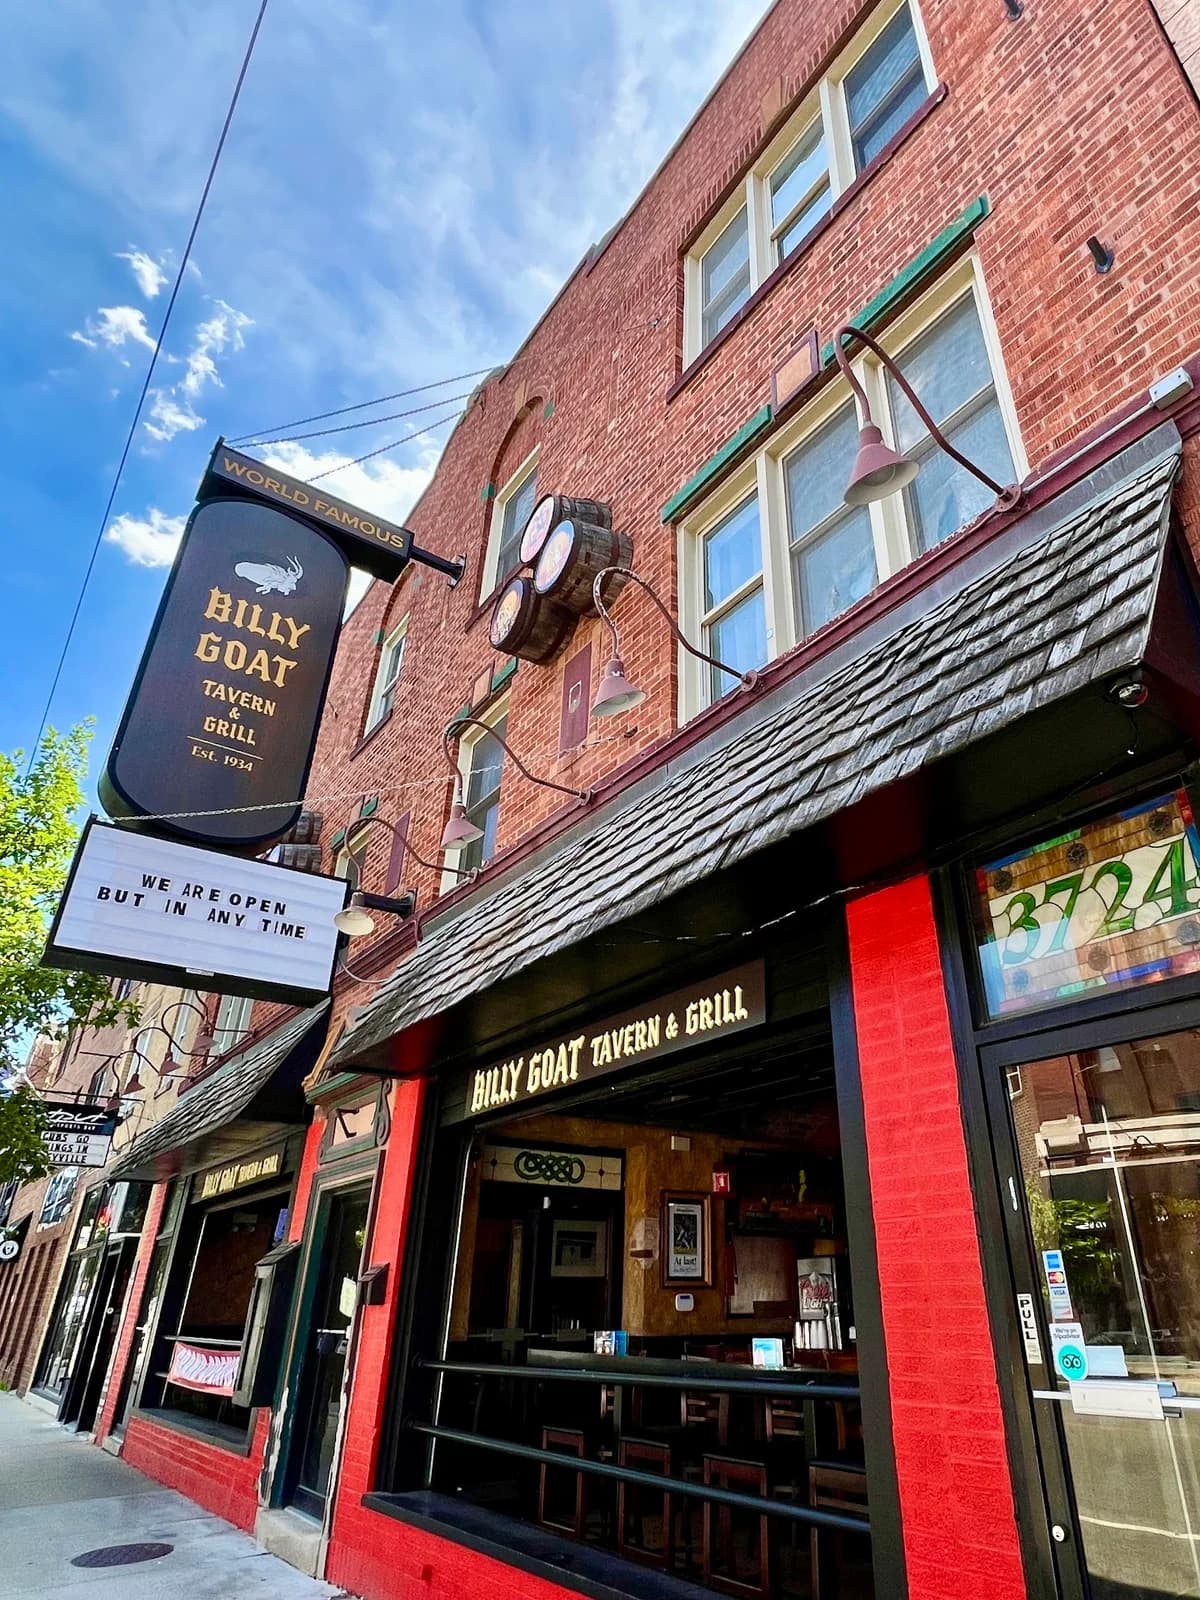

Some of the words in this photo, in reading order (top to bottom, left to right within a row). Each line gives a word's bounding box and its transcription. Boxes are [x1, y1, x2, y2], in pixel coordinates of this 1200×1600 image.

[224, 457, 310, 506] WORLD
[314, 499, 405, 549] FAMOUS
[204, 586, 311, 650] BILLY
[194, 632, 298, 688] GOAT
[202, 679, 277, 717] TAVERN
[228, 706, 241, 720] &
[203, 716, 256, 746] GRILL
[191, 745, 219, 762] Est.
[223, 754, 254, 772] 1934
[97, 886, 145, 907] BUT
[164, 899, 188, 916] IN
[207, 908, 246, 927] ANY
[262, 919, 306, 939] TIME
[142, 873, 171, 892] WE
[182, 883, 221, 900] ARE
[229, 893, 287, 916] OPEN
[1002, 839, 1197, 965] 3724
[471, 1056, 524, 1112] BILLY
[526, 1034, 585, 1094] GOAT
[590, 1013, 661, 1067] TAVERN
[665, 1011, 679, 1040] &
[685, 984, 749, 1036] GRILL
[42, 1132, 68, 1143] CUBS
[76, 1134, 90, 1144] GO
[48, 1142, 74, 1153] INGS
[1020, 1299, 1037, 1340] PULL
